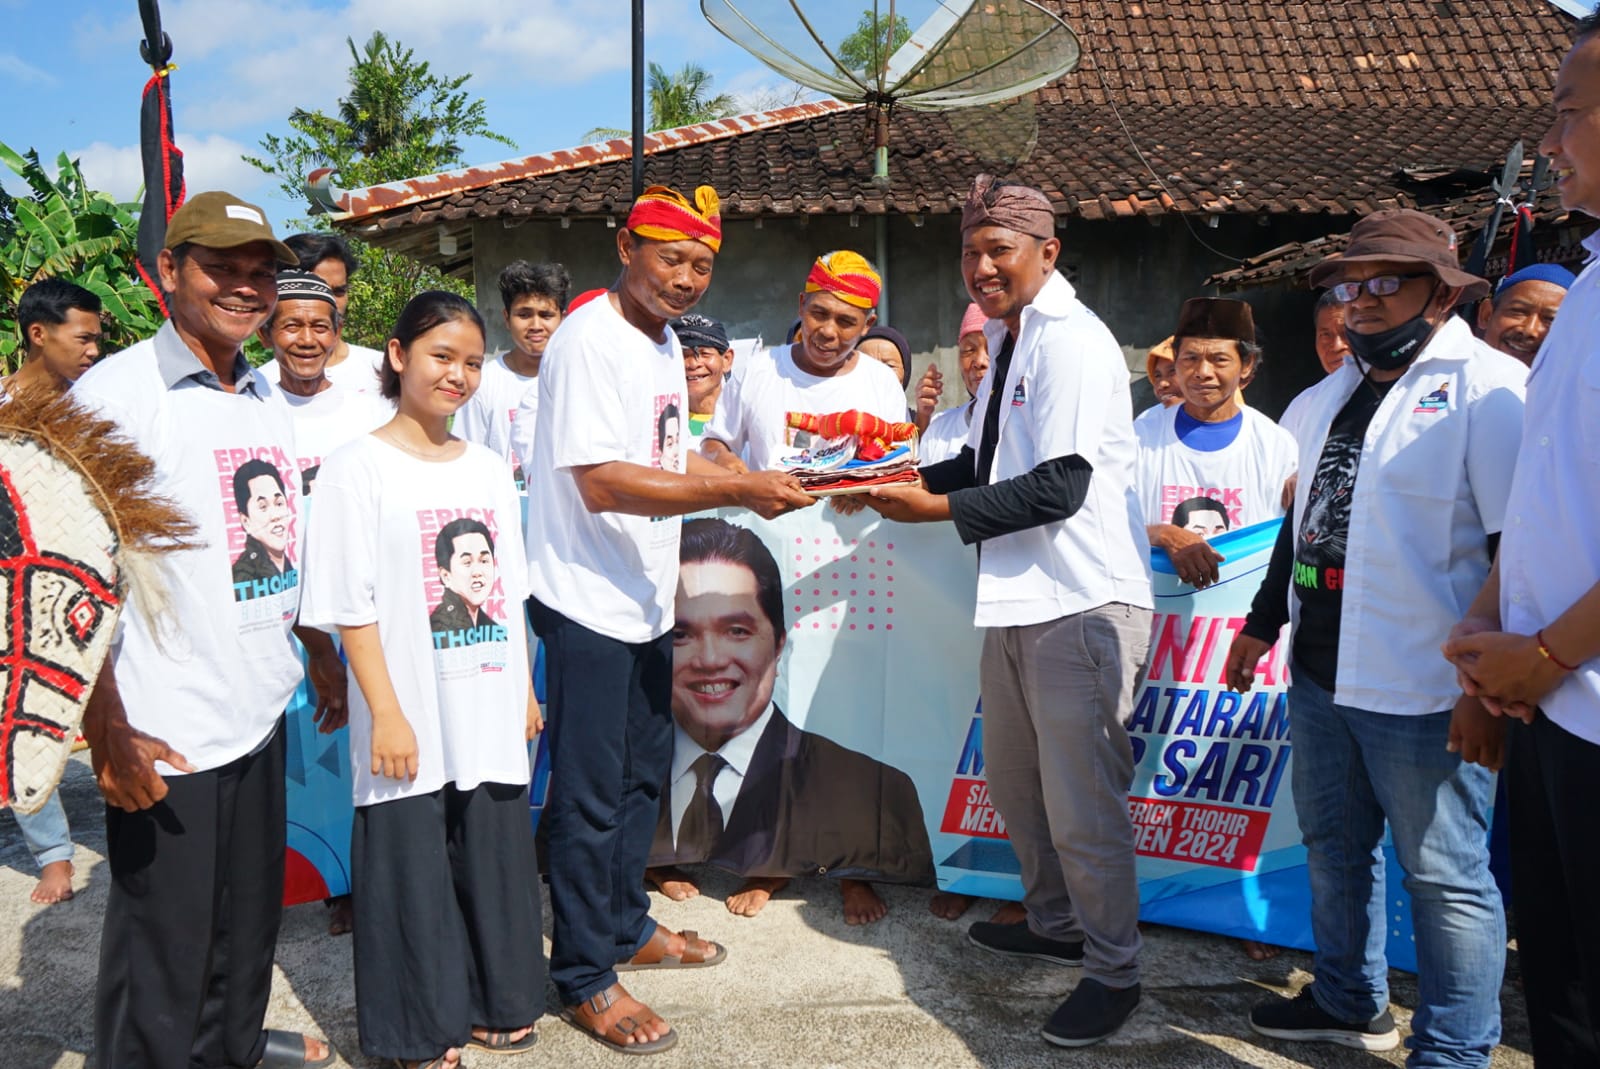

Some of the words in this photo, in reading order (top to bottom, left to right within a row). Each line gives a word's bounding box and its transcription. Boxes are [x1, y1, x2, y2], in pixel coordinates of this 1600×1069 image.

[213, 446, 292, 473] ERICK
[1162, 485, 1243, 506] ERICK
[416, 507, 498, 531] ERICK
[232, 569, 298, 602] THOHIR
[1127, 687, 1291, 740] ATARAM
[1153, 739, 1291, 808] SARI
[960, 805, 1008, 835] MEN
[1173, 829, 1239, 863] 2024
[1128, 801, 1178, 826] ERICK
[1181, 807, 1249, 837] THOHIR
